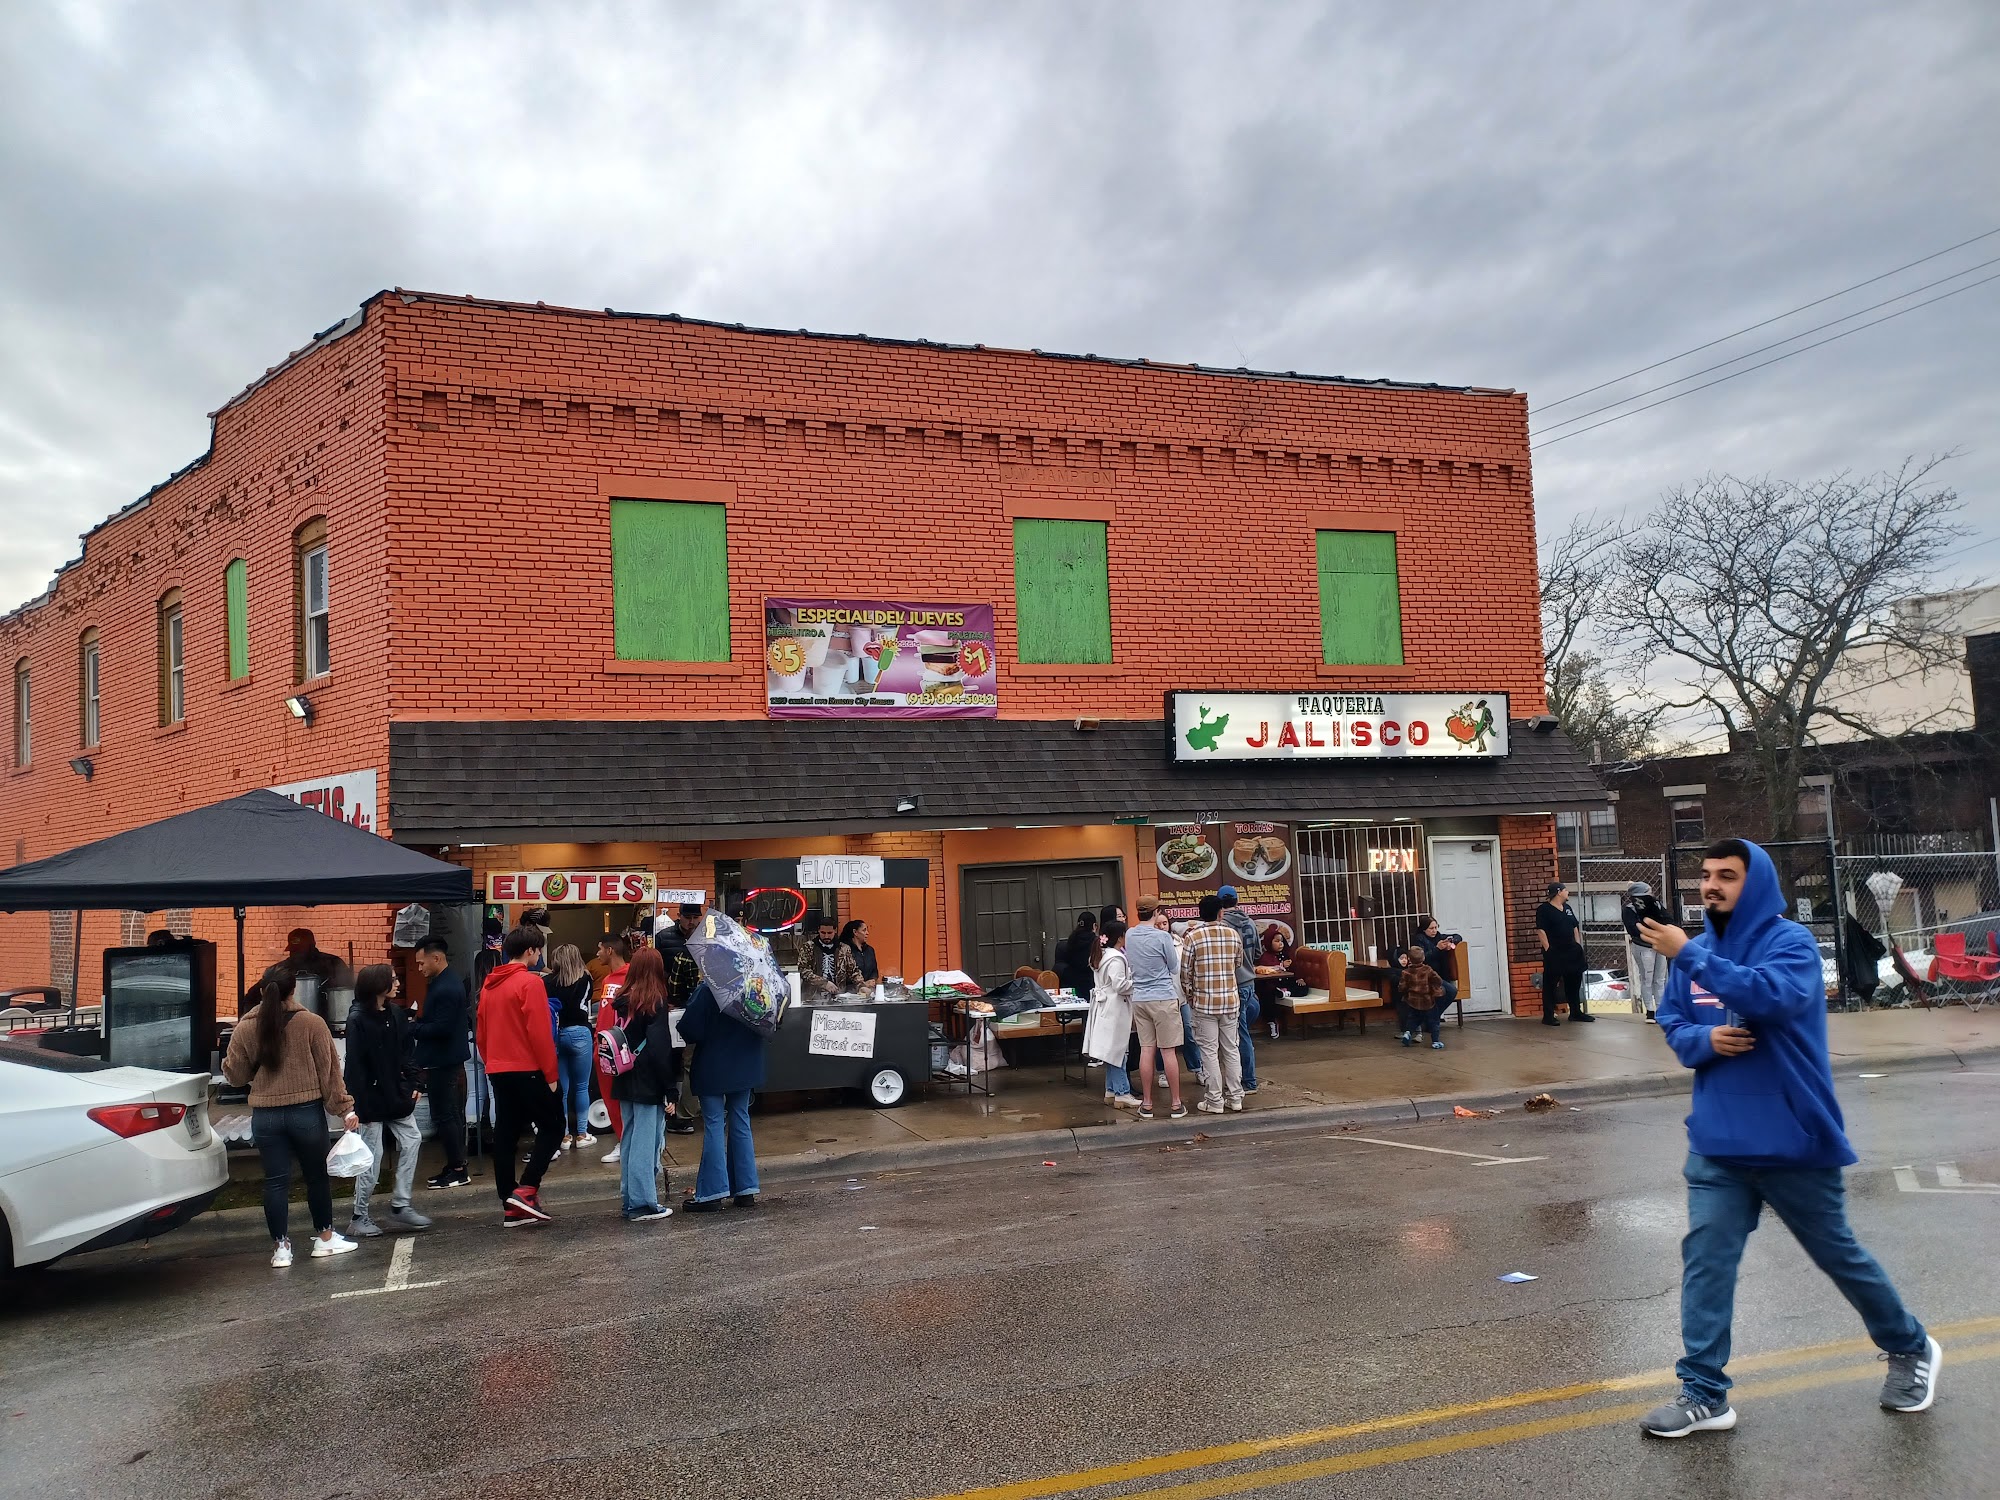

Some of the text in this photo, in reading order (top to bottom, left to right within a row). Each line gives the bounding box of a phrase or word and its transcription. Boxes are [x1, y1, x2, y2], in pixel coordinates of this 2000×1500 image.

[797, 608, 873, 625] ESPECIAL
[906, 611, 964, 627] JUEVES
[771, 643, 800, 673] $5
[963, 646, 988, 673] $1
[855, 697, 869, 706] City
[906, 692, 995, 705] (913) 804-5042
[1297, 697, 1386, 716] TAQUERIA
[1245, 720, 1430, 749] JALISCO
[1195, 811, 1219, 824] 1259
[1168, 824, 1202, 835] TACOS
[1235, 823, 1274, 834] TORTAS
[801, 860, 871, 885] ELOTES
[493, 873, 644, 902] ELOTES
[144, 955, 179, 965] PEPSI
[813, 1013, 863, 1031] Mexican
[812, 1033, 872, 1052] Street corn
